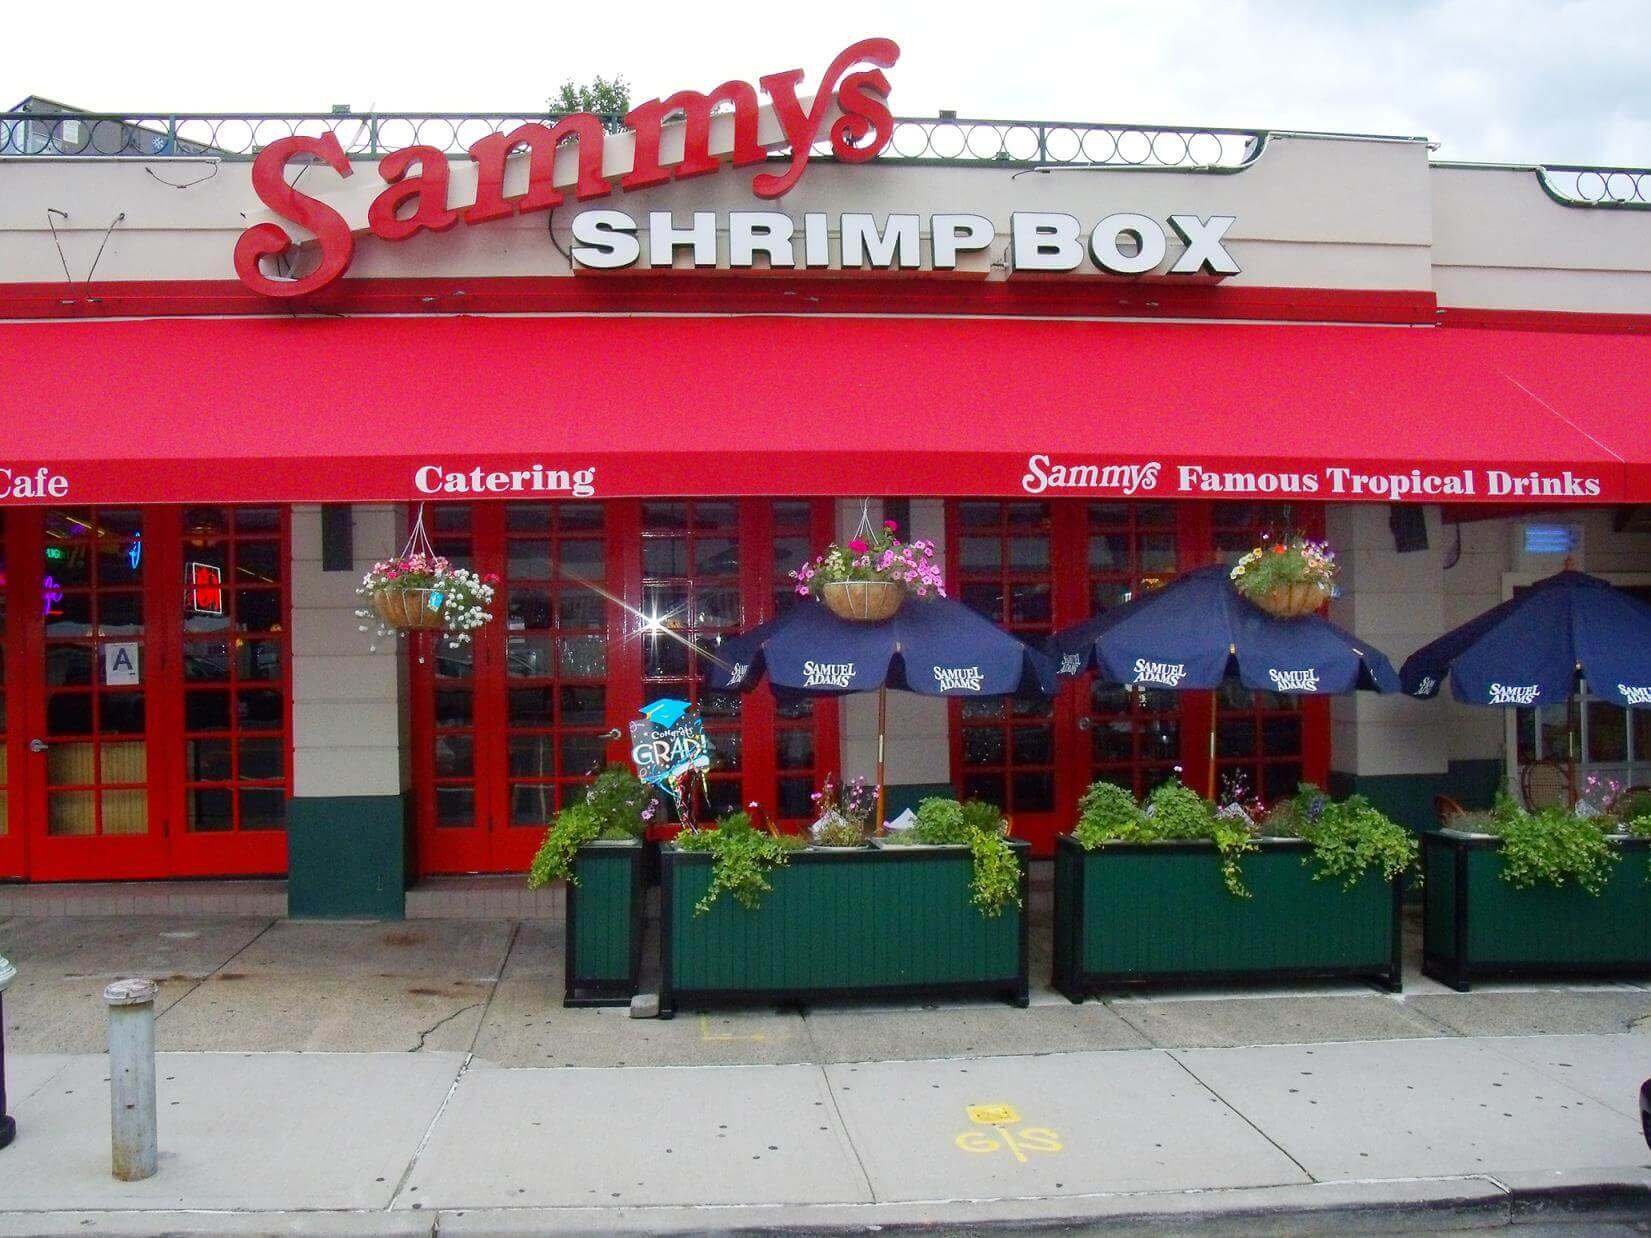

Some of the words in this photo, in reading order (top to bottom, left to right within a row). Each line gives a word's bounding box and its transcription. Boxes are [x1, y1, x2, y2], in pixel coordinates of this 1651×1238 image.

[234, 37, 901, 297] Sammys
[571, 209, 996, 271] SHRIMP
[1010, 211, 1242, 275] BOX
[415, 464, 596, 497] Catering
[1022, 454, 1161, 494] Sammys
[1177, 465, 1319, 492] Famous
[1326, 467, 1476, 500] Tropical
[1487, 470, 1601, 496] Drinks
[113, 648, 133, 670] A
[803, 661, 856, 677] SAMUEL
[934, 666, 984, 681] SAMUEL
[1133, 659, 1187, 677] SAMUEL
[1268, 668, 1320, 683] SAMUEL
[803, 674, 850, 688] ADAMS
[940, 677, 981, 692] ADAMS
[1133, 673, 1179, 687] ADAMS
[1277, 679, 1317, 692] ADAMS
[1489, 683, 1541, 696] SAMUEL
[1489, 693, 1534, 704] ADAMS
[632, 734, 707, 766] GRAD!
